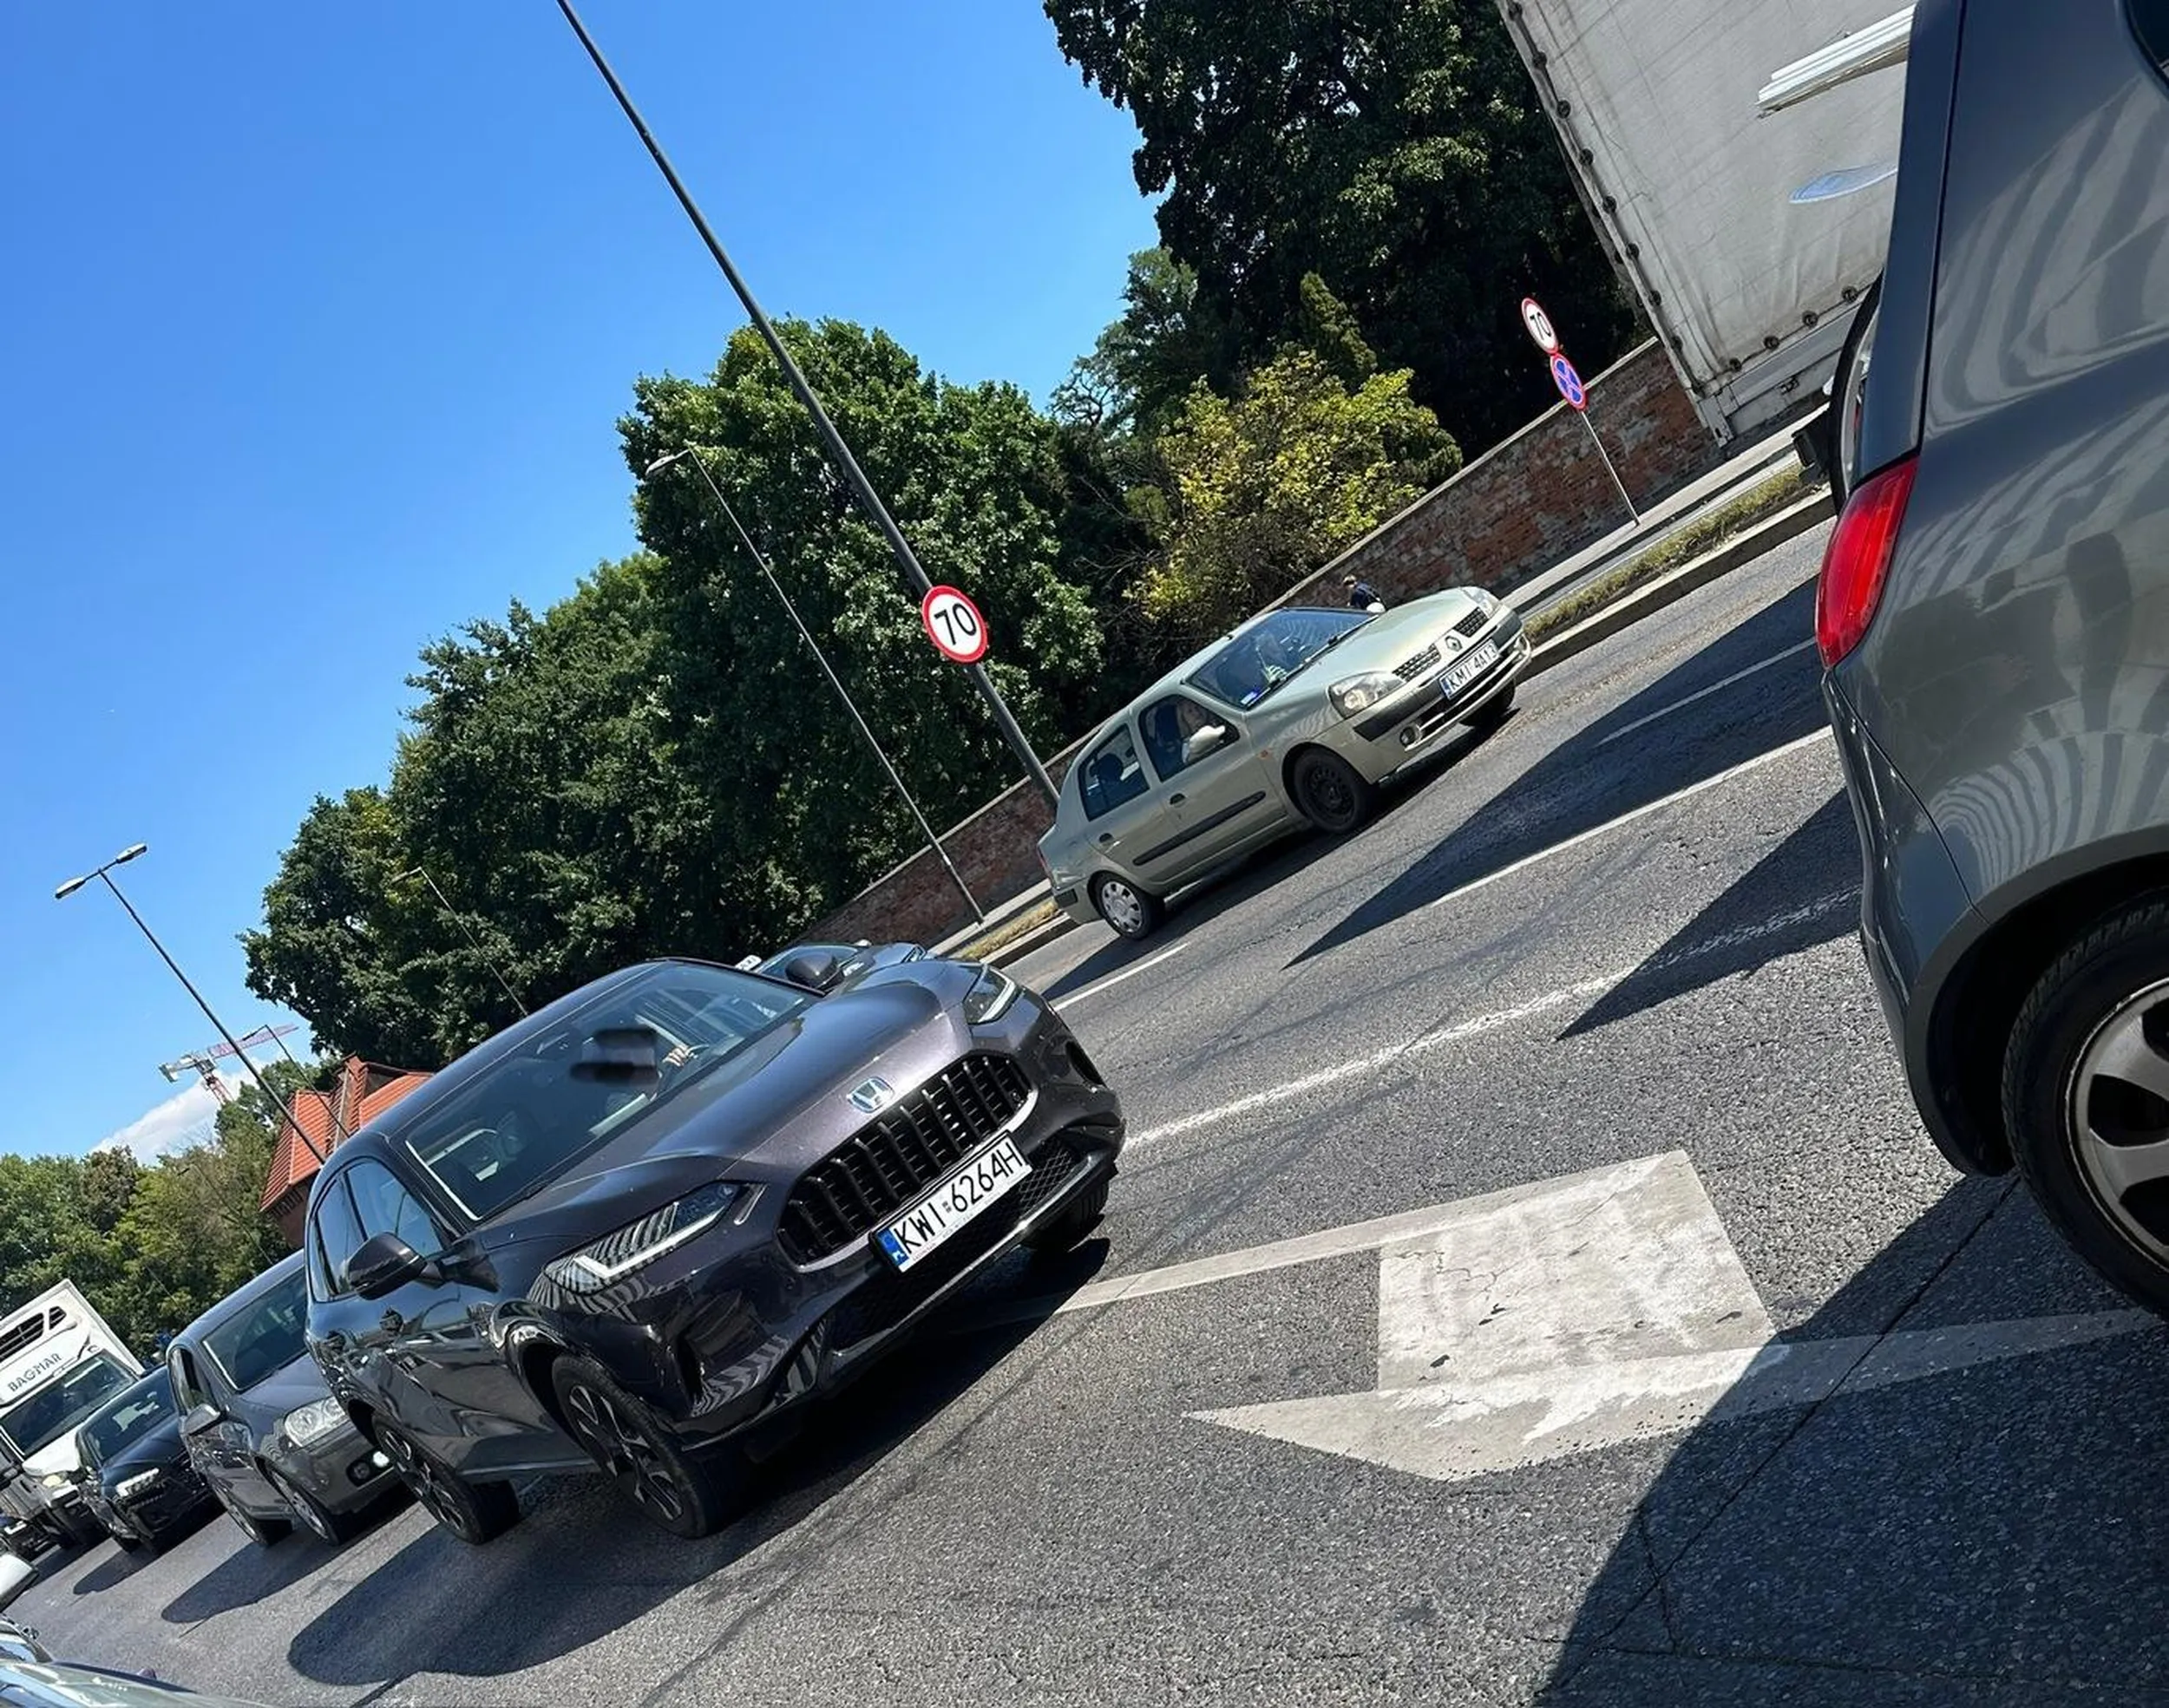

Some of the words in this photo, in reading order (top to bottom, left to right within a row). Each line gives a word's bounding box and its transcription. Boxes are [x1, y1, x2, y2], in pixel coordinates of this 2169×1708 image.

[1529, 311, 1551, 341] 70
[934, 603, 977, 645] 70
[894, 1202, 946, 1253] KWI
[951, 1142, 1024, 1213] 6264H
[8, 1353, 62, 1392] BAGMAR
